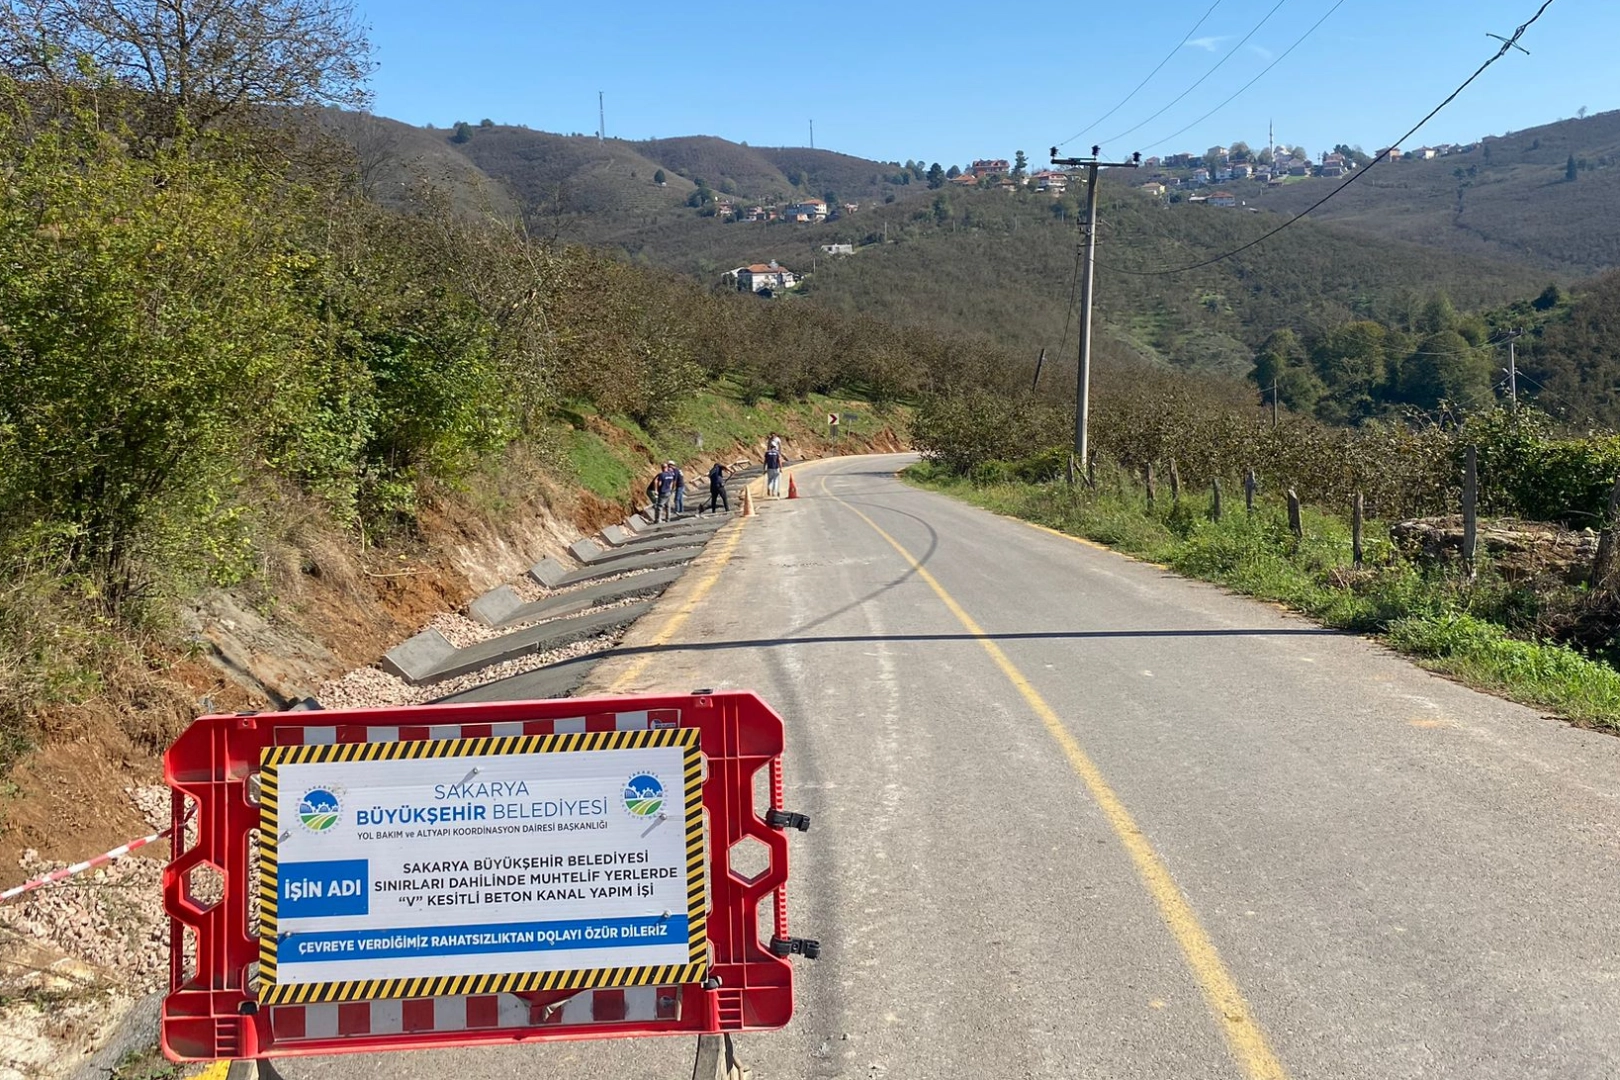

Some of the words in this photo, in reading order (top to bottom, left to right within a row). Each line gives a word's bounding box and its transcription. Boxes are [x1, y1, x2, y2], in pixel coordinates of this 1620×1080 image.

[434, 780, 529, 800] SAKARYA
[356, 802, 487, 826] BÜYÜKŞEHİR
[492, 796, 608, 820] BELEDİYESİ
[357, 831, 374, 841] YOL
[376, 829, 404, 840] BAKIM
[405, 830, 415, 838] ve
[416, 828, 450, 838] ALTYAPI
[452, 824, 520, 837] KOORDİNASYON
[522, 821, 556, 834] DAİRESİ
[557, 819, 608, 833] BAŞKANLIĞI
[402, 860, 470, 874] SAKARYA
[473, 855, 564, 872] BÜYÜKŞEHİR
[567, 849, 649, 867] BELEDİYESİ
[284, 877, 322, 902] İŞİN
[326, 879, 361, 898] ADI
[374, 877, 444, 892] SINIRLARI
[449, 872, 526, 889] DAHİLİNDE
[530, 869, 600, 885] MUHTELİF
[604, 867, 678, 881] YERLERDE
[427, 891, 480, 907] KESİTLİ
[484, 891, 532, 904] BETON
[536, 888, 586, 902] KANAL
[590, 887, 632, 899] YAPIM
[637, 881, 654, 899] İŞİ
[298, 939, 355, 955] ÇEVREYE
[358, 934, 428, 951] VERDİĞİMİZ
[431, 931, 534, 948] RAHATSIZLIKTAN
[537, 929, 582, 944] DOLAYI
[584, 926, 618, 940] ÖZÜR
[621, 923, 668, 939] DİLERİZ
